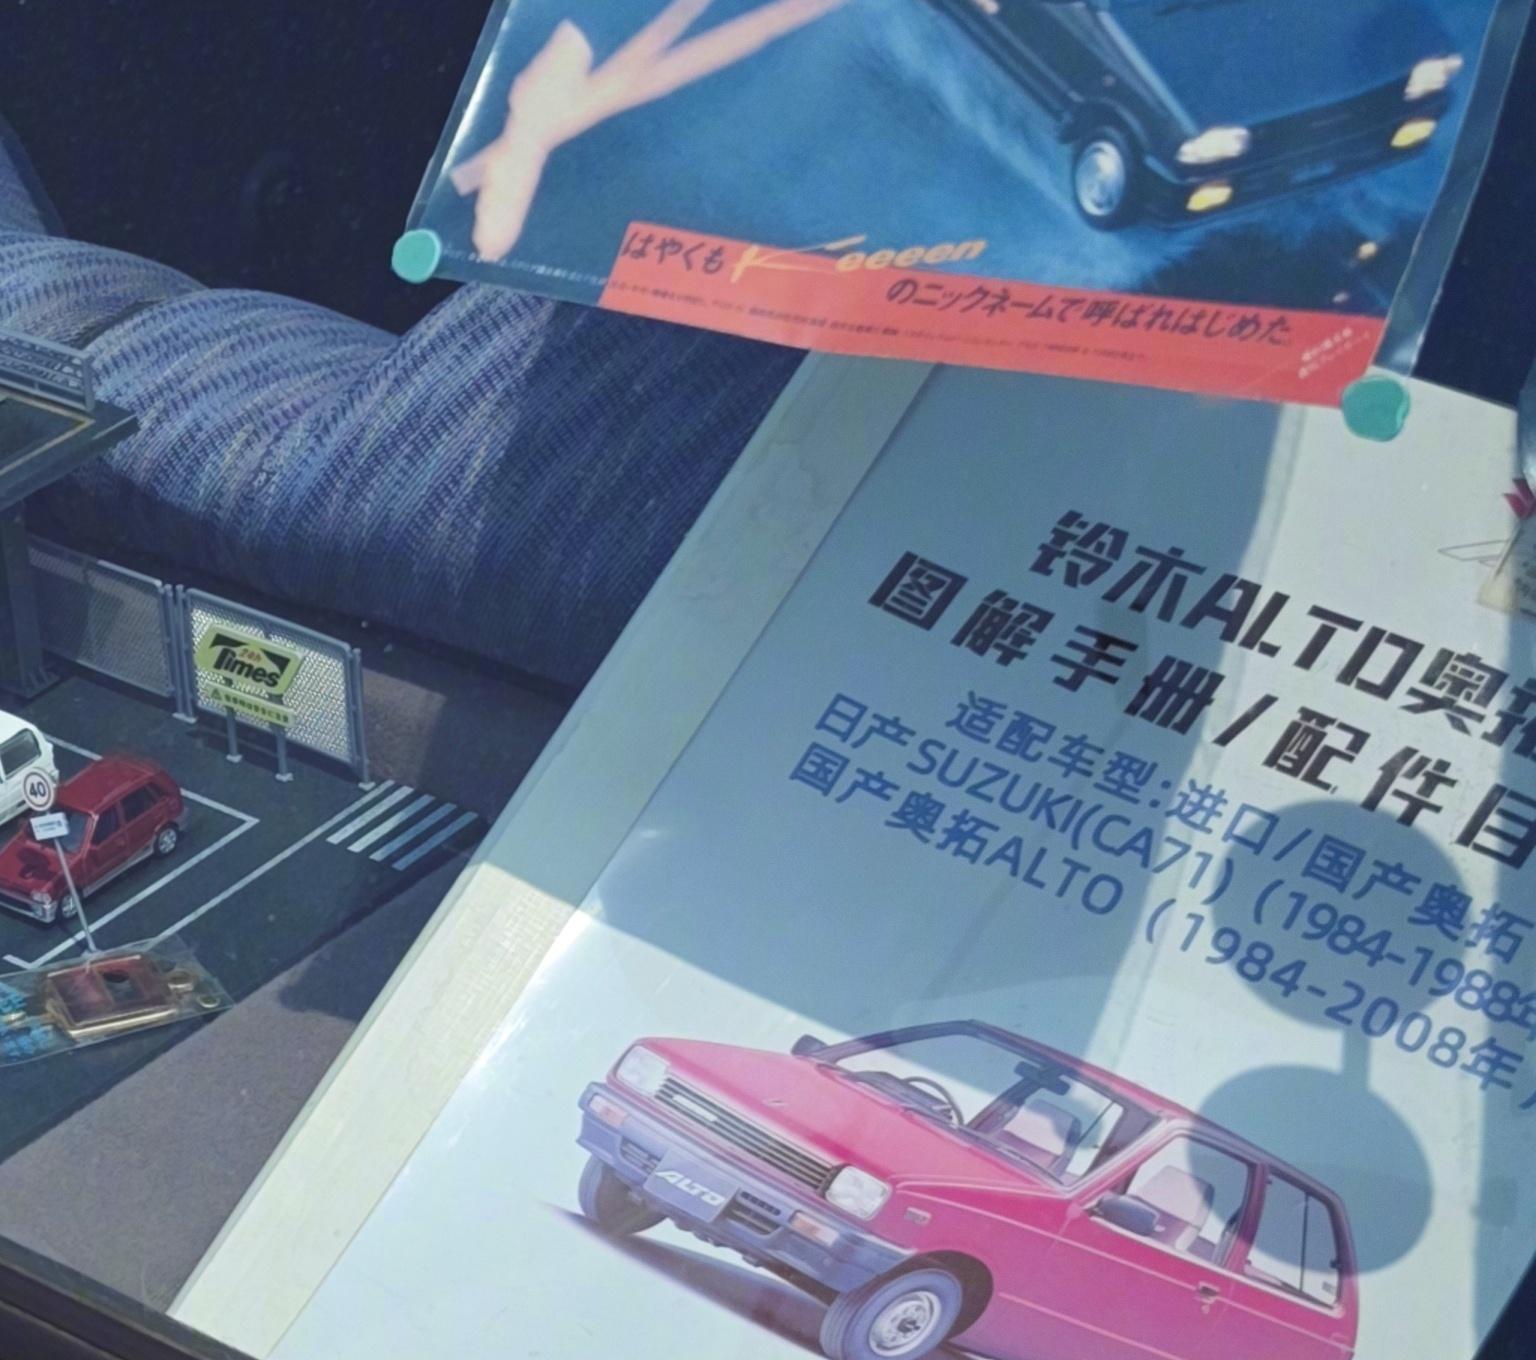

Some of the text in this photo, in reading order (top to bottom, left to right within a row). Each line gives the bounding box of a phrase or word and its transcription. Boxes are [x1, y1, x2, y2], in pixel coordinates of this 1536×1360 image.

[621, 231, 725, 275] はやくも
[213, 647, 282, 689] Times
[29, 781, 47, 798] 40
[789, 741, 1125, 917] 国产奥拓ALTO
[653, 1168, 727, 1207] ALTO
